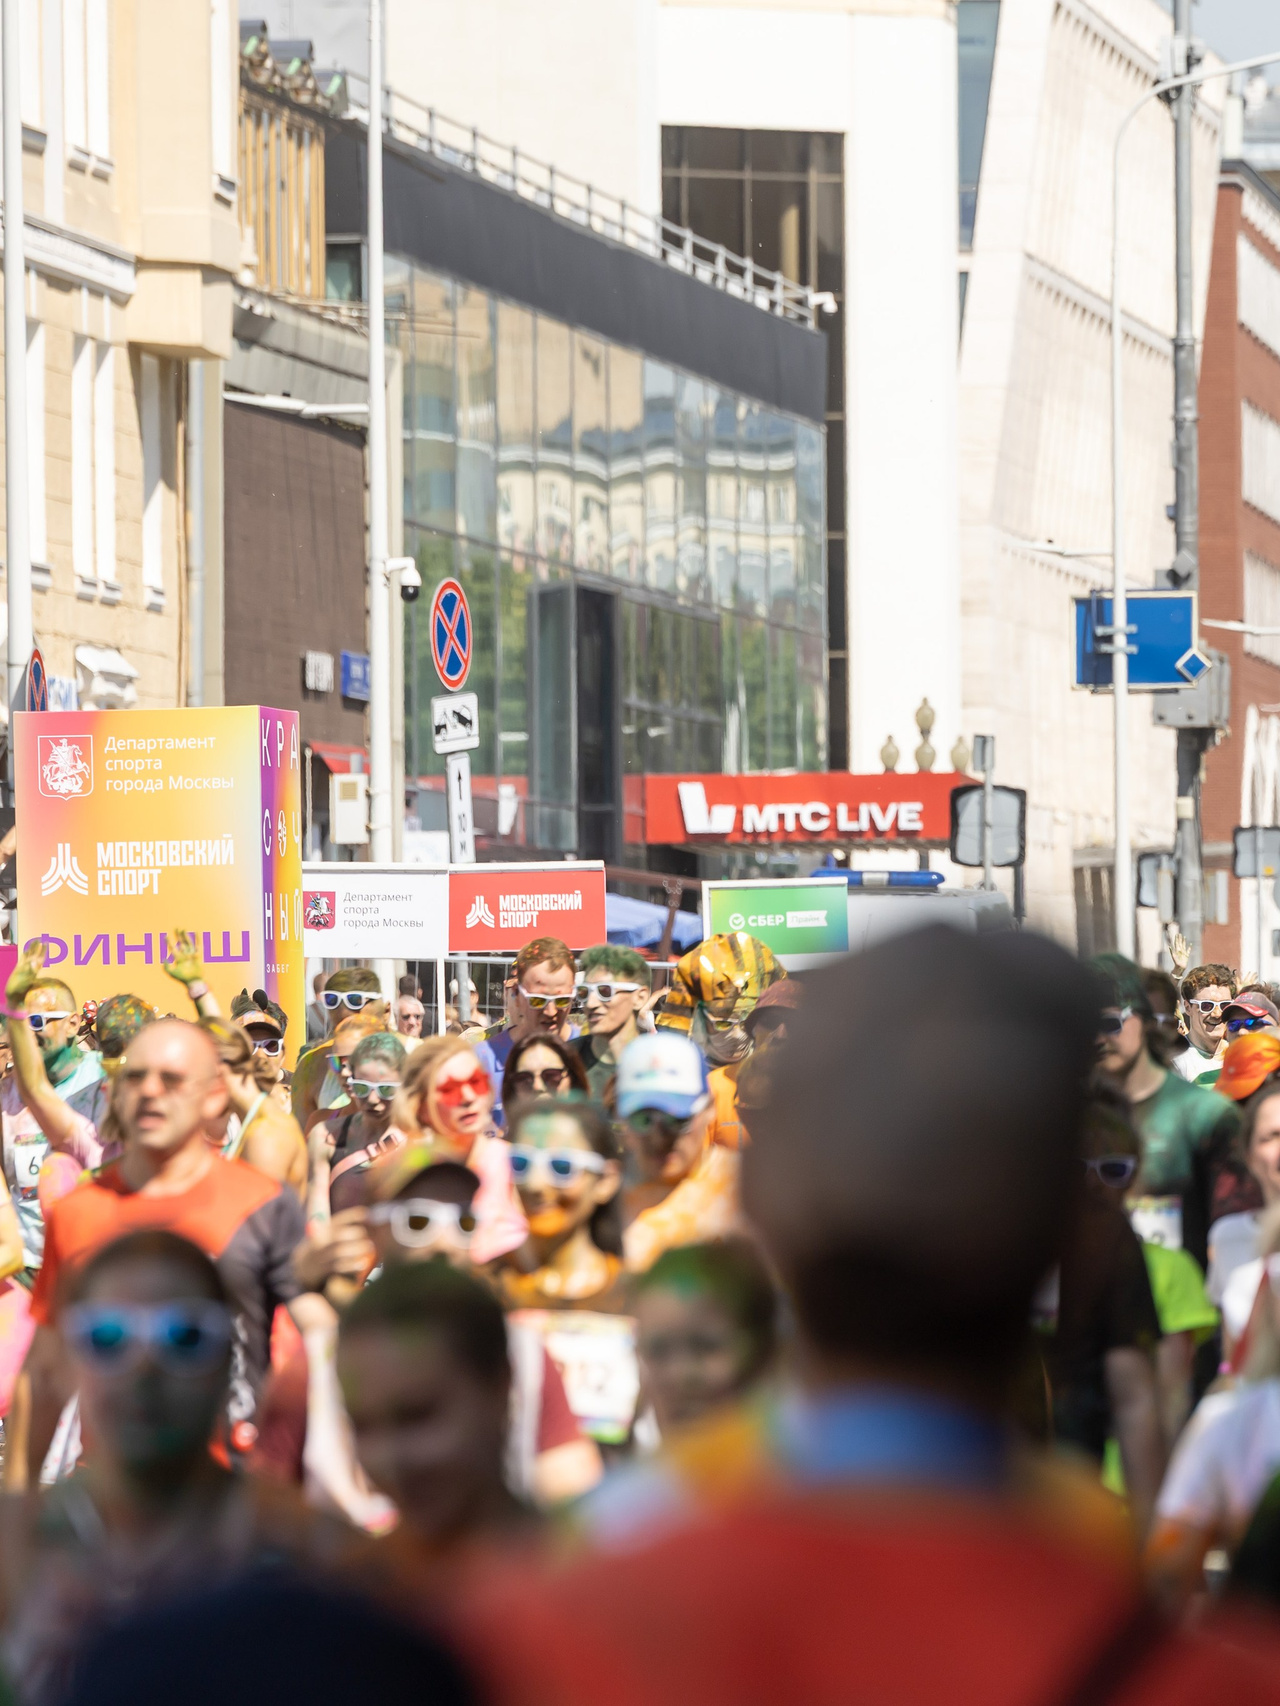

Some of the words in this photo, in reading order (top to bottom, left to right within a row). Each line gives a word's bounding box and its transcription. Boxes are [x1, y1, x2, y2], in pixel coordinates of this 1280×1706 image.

[104, 735, 216, 754] Департамент
[105, 756, 162, 773] спорта
[106, 777, 164, 795] города
[168, 775, 234, 791] Москвы
[837, 801, 923, 832] LIVE
[97, 833, 235, 868] МОСКОВСКИЙ
[97, 868, 162, 896] СПОРТ
[343, 891, 413, 904] Департамент
[499, 890, 582, 911] МОСКОВСКИЙ
[343, 905, 380, 916] спорта
[499, 910, 539, 928] СПОРТ
[343, 918, 380, 929] города
[382, 917, 424, 928] Москвы
[748, 914, 785, 927] СБЕР
[266, 963, 290, 974] ЗАБЕГ
